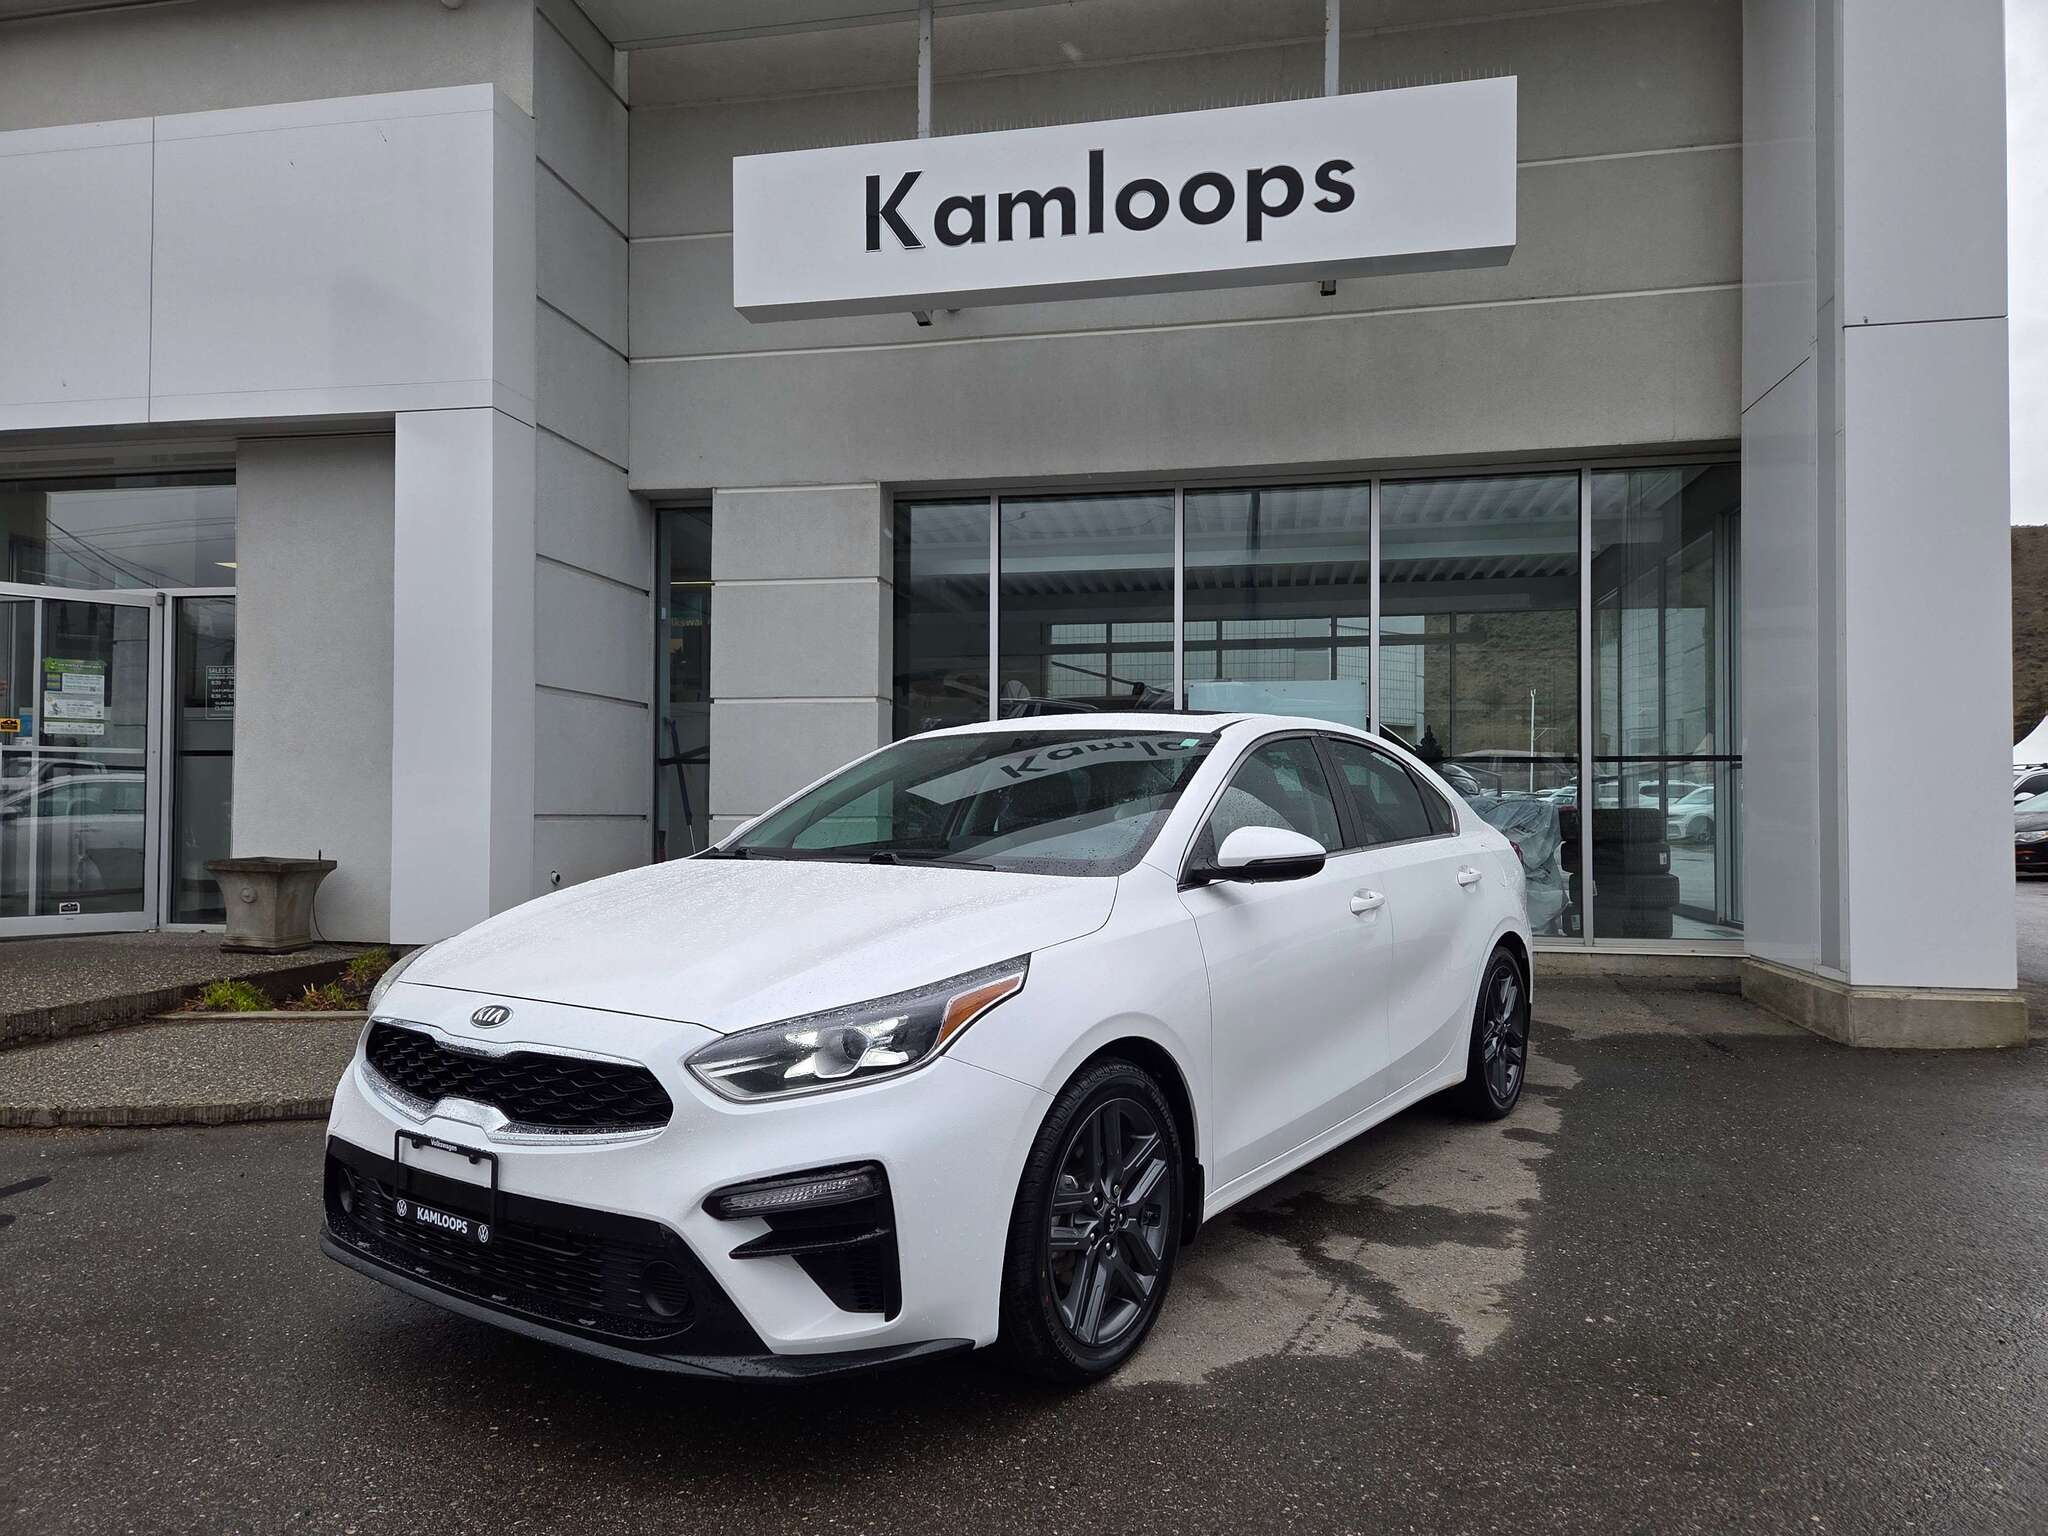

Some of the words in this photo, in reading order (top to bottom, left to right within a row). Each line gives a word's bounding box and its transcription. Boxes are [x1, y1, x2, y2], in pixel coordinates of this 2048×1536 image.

[866, 148, 1356, 253] Kamloops
[473, 1007, 505, 1023] KIA
[430, 1138, 458, 1152] Volkswagen
[417, 1206, 468, 1235] KAMLOOPS
